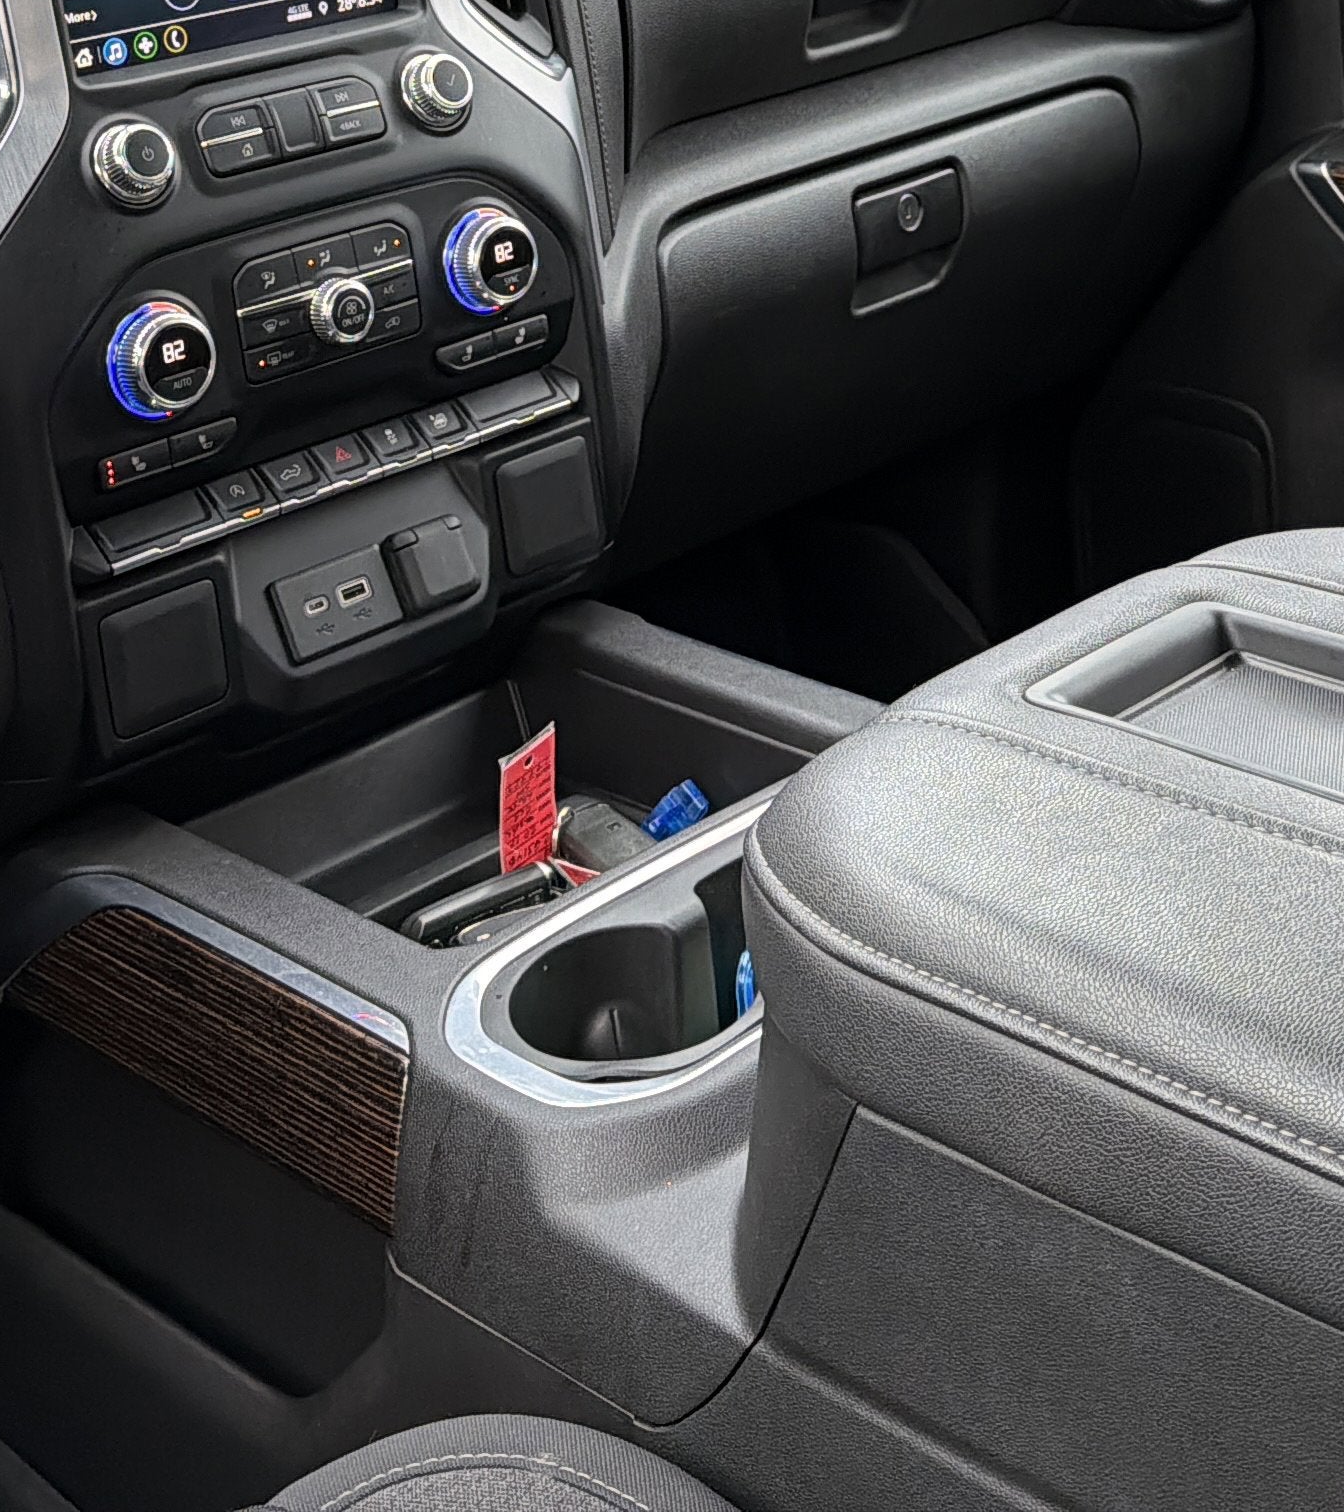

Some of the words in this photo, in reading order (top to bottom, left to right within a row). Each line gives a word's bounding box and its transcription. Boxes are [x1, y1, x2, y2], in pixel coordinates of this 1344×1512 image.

[64, 11, 91, 25] More
[494, 240, 515, 264] 82
[341, 314, 365, 328] ON/OFF
[162, 339, 187, 364] 82
[172, 376, 193, 390] AUTO
